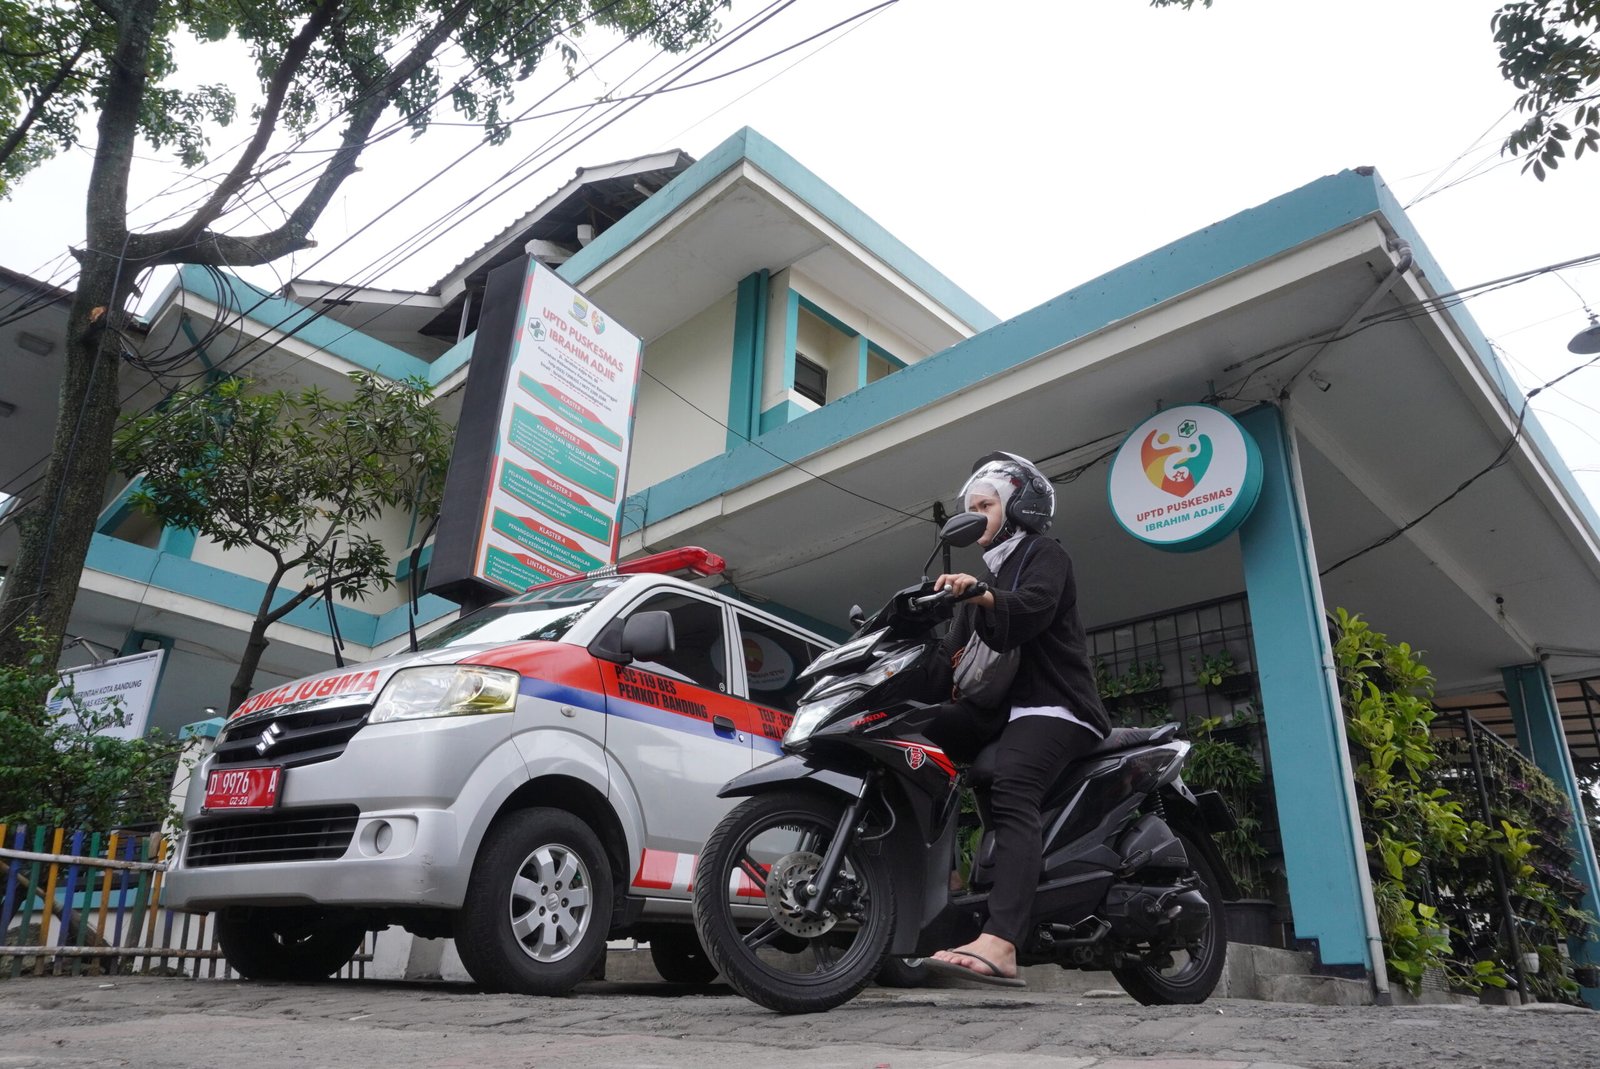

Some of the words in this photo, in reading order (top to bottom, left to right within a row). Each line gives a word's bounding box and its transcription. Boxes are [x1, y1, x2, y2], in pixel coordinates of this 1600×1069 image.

[542, 306, 567, 332] UPTD
[568, 326, 624, 373] PUSKESMAS
[548, 327, 589, 364] IBRAHIM
[590, 357, 615, 383] ADJIE
[560, 394, 580, 411] KLASTER
[536, 423, 564, 445] KESEHATAN
[565, 441, 574, 451] IBU
[575, 447, 585, 458] DAN
[586, 454, 600, 467] ANAK
[555, 425, 576, 442] KLASTER
[507, 469, 532, 486] PELAYANAN
[533, 483, 556, 500] KESEHATAN
[583, 510, 592, 519] DAN
[546, 479, 568, 495] KLASTER
[1136, 507, 1164, 522] UPTD
[1167, 487, 1233, 514] PUSKESMAS
[1145, 513, 1191, 532] IBRAHIM
[1193, 503, 1225, 518] ADJIE
[508, 522, 550, 547] PENANGGULANGAN
[550, 543, 570, 556] PENYAKIT
[570, 553, 590, 566] MENULAR
[539, 525, 560, 541] KLASTER
[517, 535, 527, 544] DAN
[528, 540, 552, 556] KESEHATAN
[553, 552, 580, 570] LINGKUNGAN
[526, 558, 545, 572] LINTAS
[546, 567, 564, 581] KLAST
[99, 685, 113, 695] KOTA
[114, 680, 142, 692] BANDUNG
[615, 666, 637, 684] PSC
[638, 672, 656, 688] 119
[658, 678, 676, 695] BES
[618, 682, 662, 707] PEMKOT
[664, 694, 708, 719] BANDUNG
[758, 708, 776, 724] TELP
[849, 711, 888, 726] HONDA
[762, 723, 782, 740] CALL
[209, 774, 218, 796] D
[222, 772, 250, 794] 9976
[268, 770, 276, 793] A
